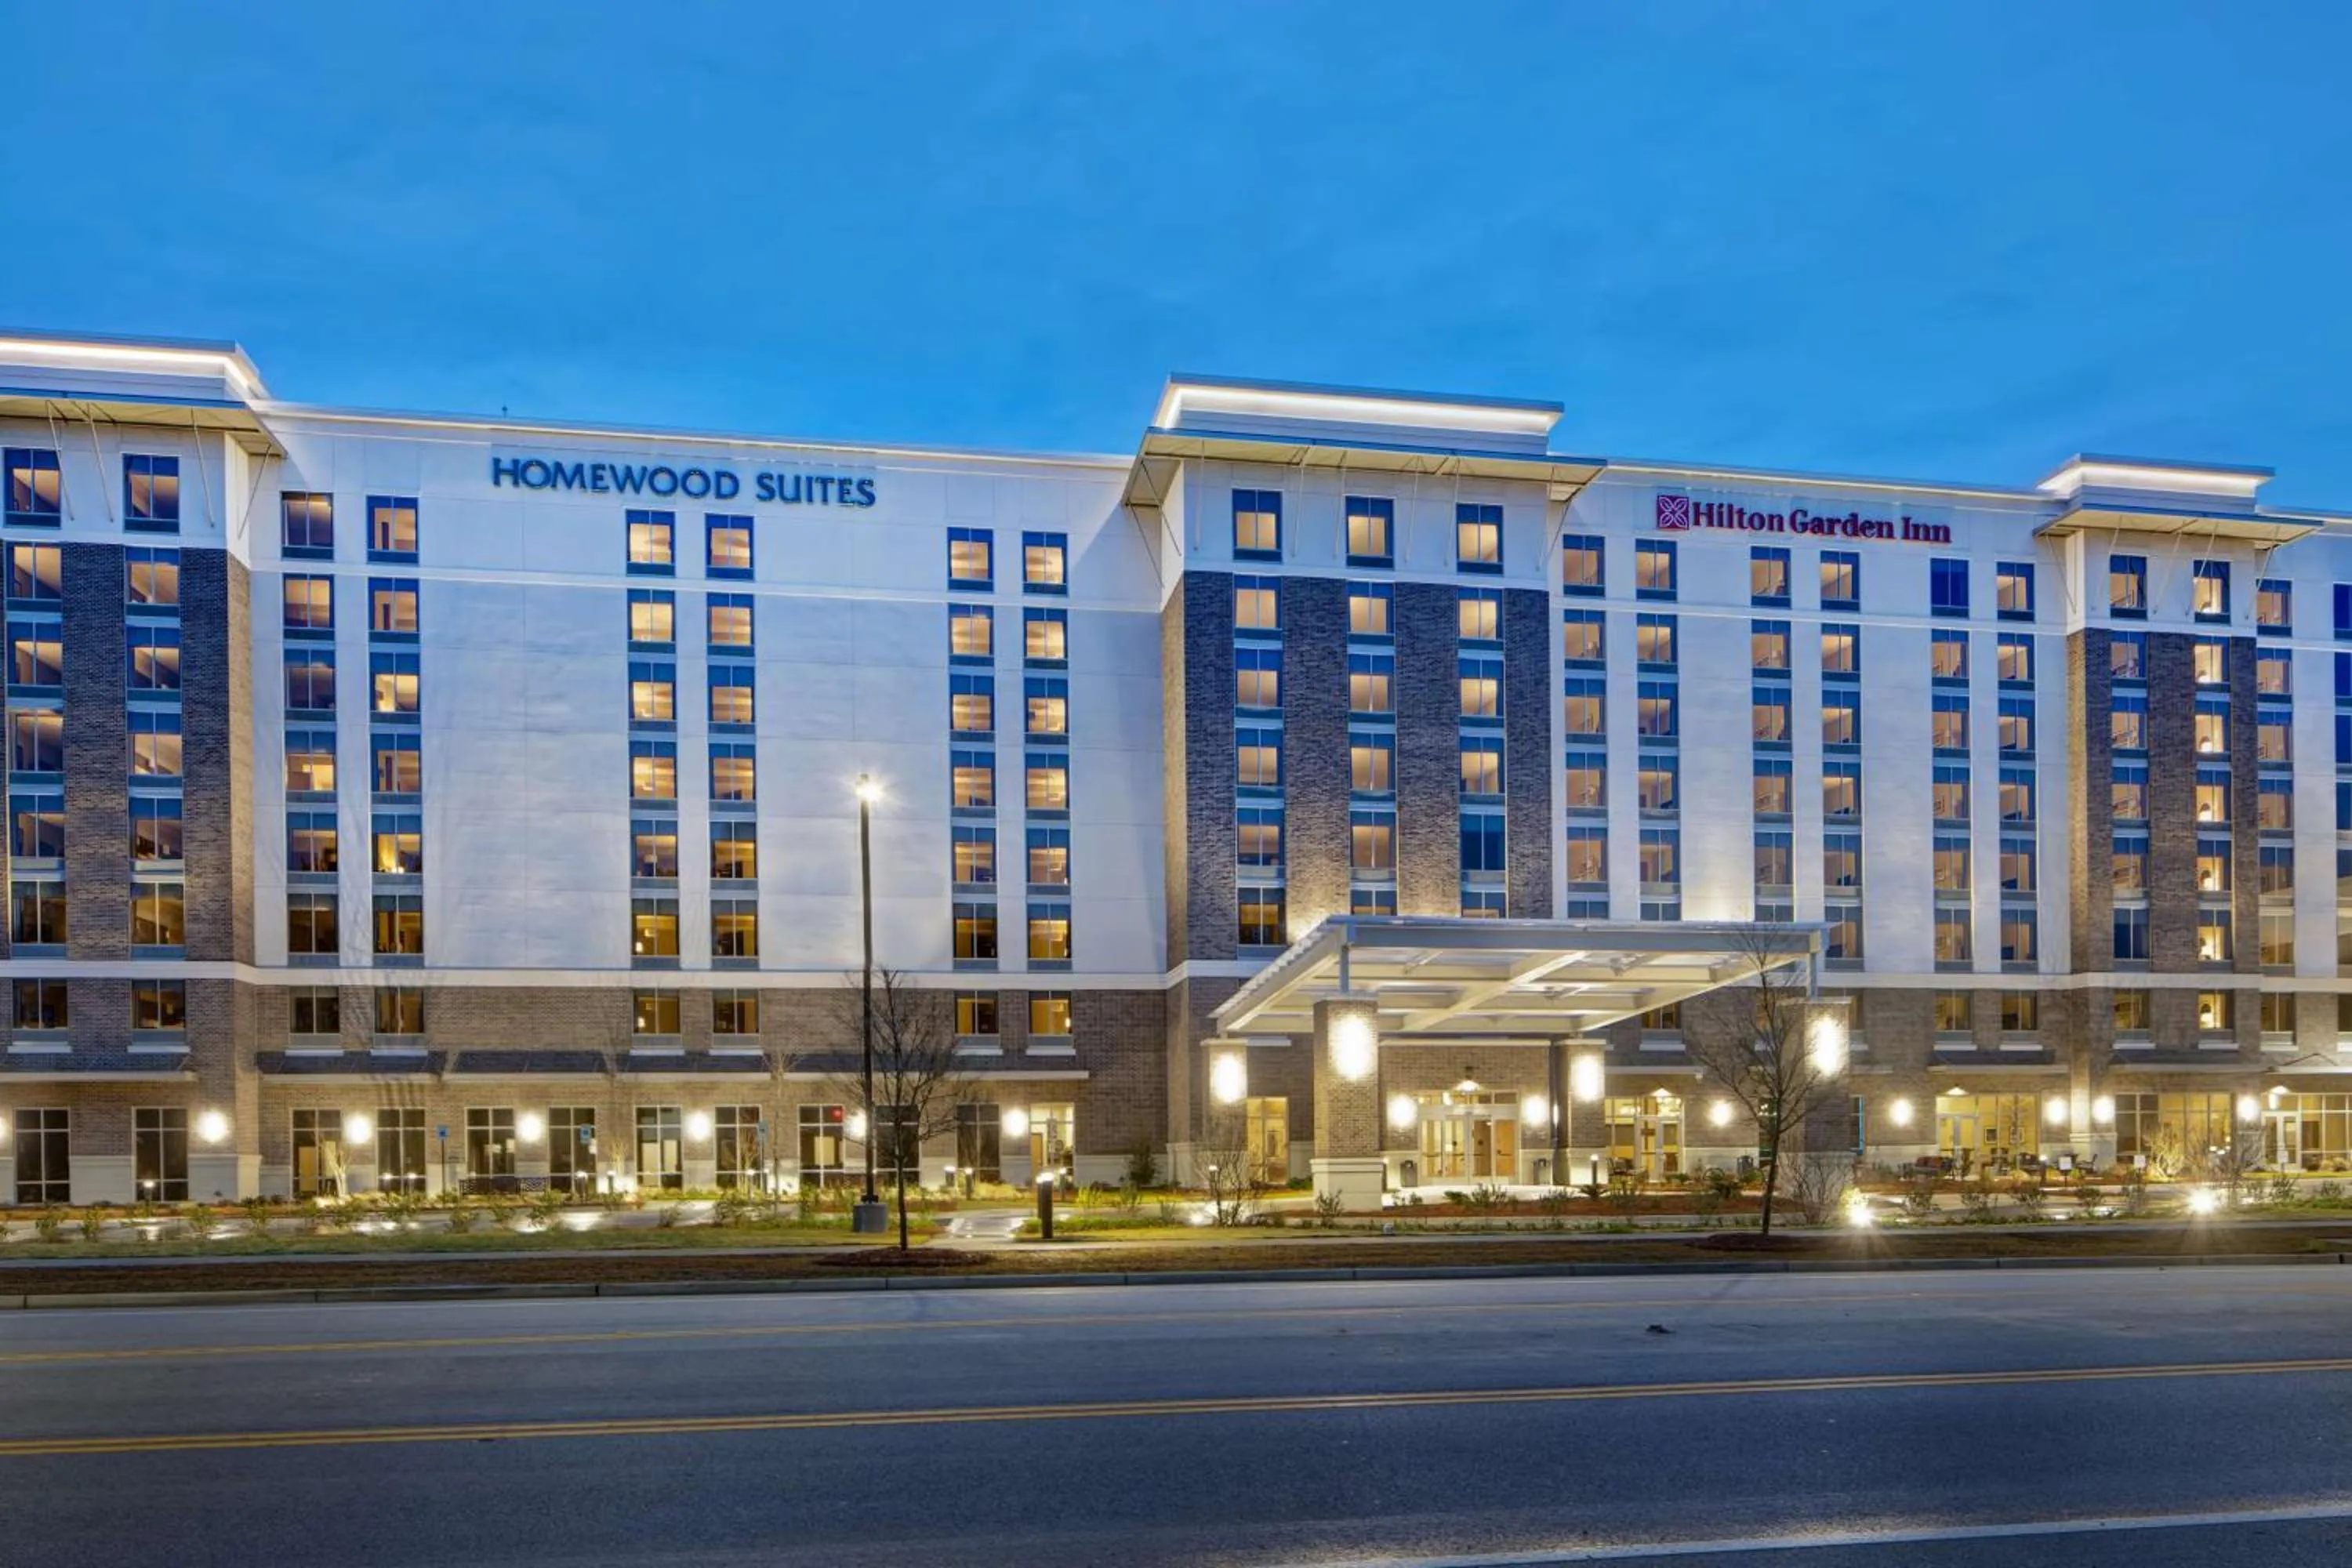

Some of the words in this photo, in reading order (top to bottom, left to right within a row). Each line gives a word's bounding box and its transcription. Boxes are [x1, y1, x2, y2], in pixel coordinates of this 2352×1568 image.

[492, 456, 740, 500] HOMEWOOD
[755, 471, 877, 507] SUITES
[1692, 500, 1785, 532] Hilton
[1789, 508, 1896, 540] Garden
[1901, 515, 1952, 543] Inn
